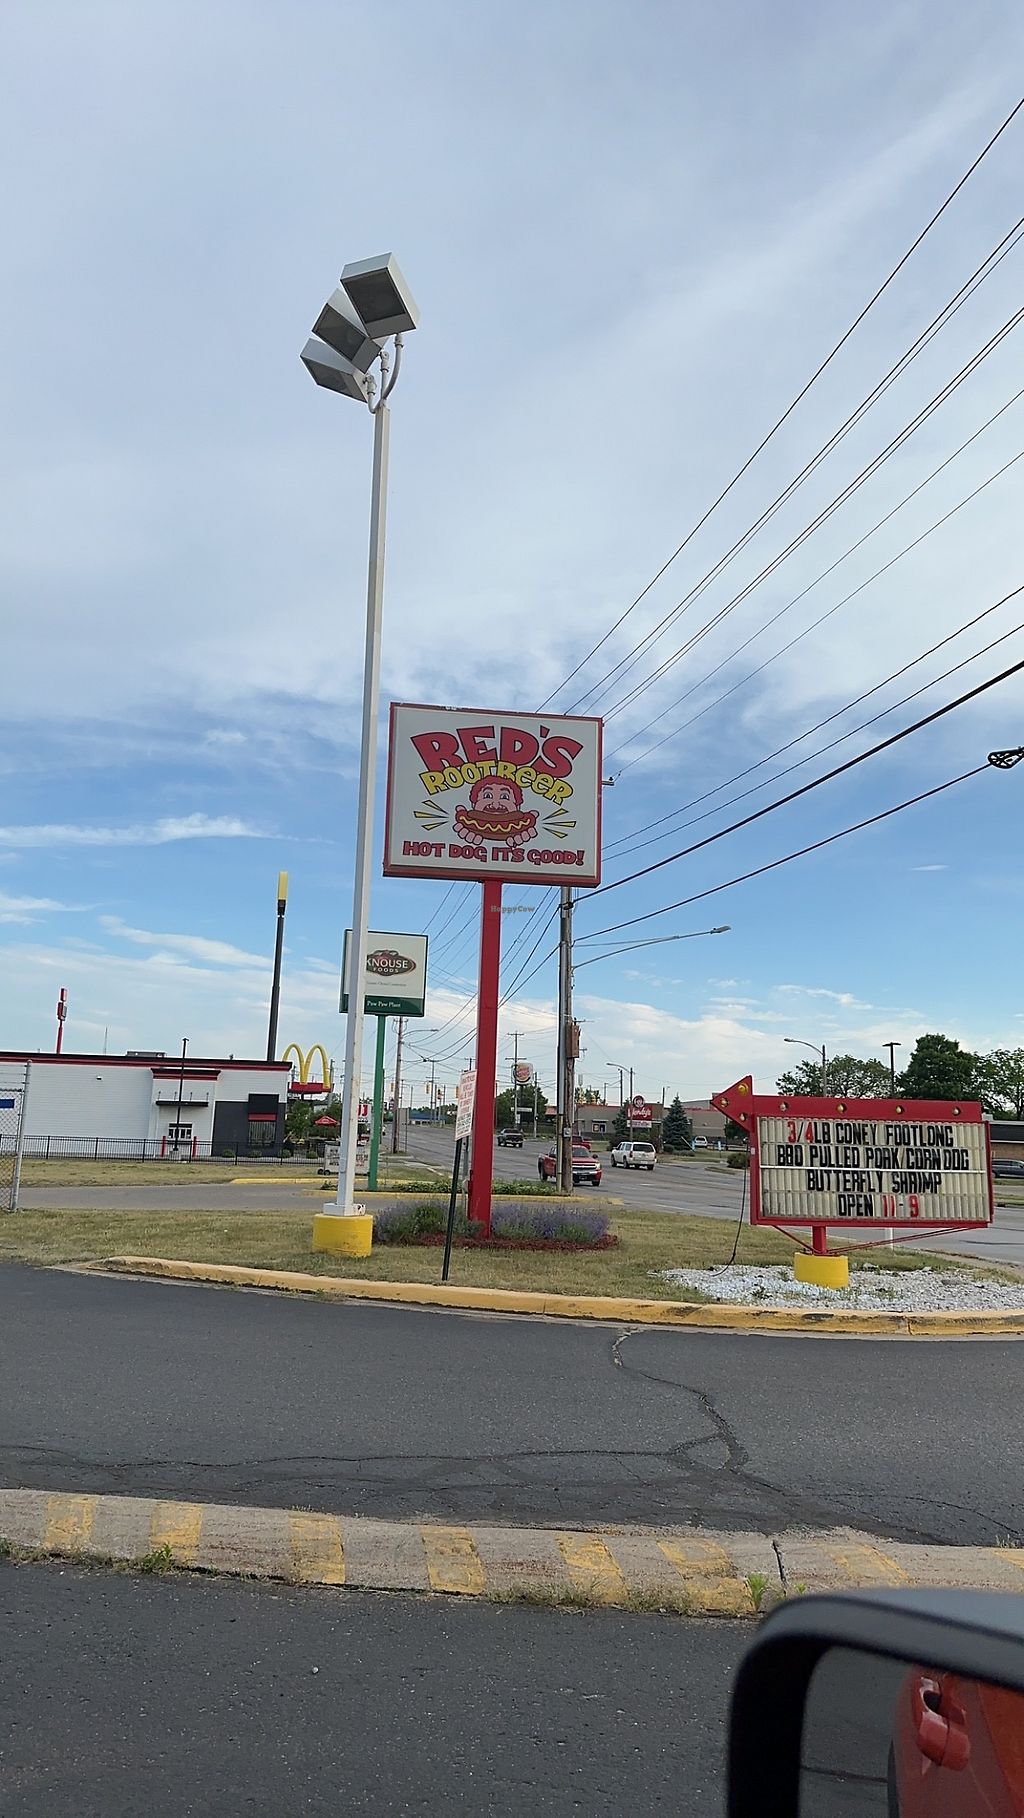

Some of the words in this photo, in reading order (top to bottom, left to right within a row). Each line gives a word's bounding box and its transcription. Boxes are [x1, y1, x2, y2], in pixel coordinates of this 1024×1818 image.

[410, 725, 584, 778] RED'S
[402, 841, 445, 858] HOT
[449, 844, 488, 862] DOG
[527, 849, 586, 866] GOOD!
[836, 1122, 878, 1146] CONEY
[885, 1124, 954, 1147] FOOTLONG
[809, 1145, 860, 1168] PULLED
[944, 1148, 970, 1170] DOG
[807, 1169, 884, 1193] BUTTERFLY
[891, 1171, 942, 1194] SHRIMP
[838, 1194, 874, 1217] OPEN
